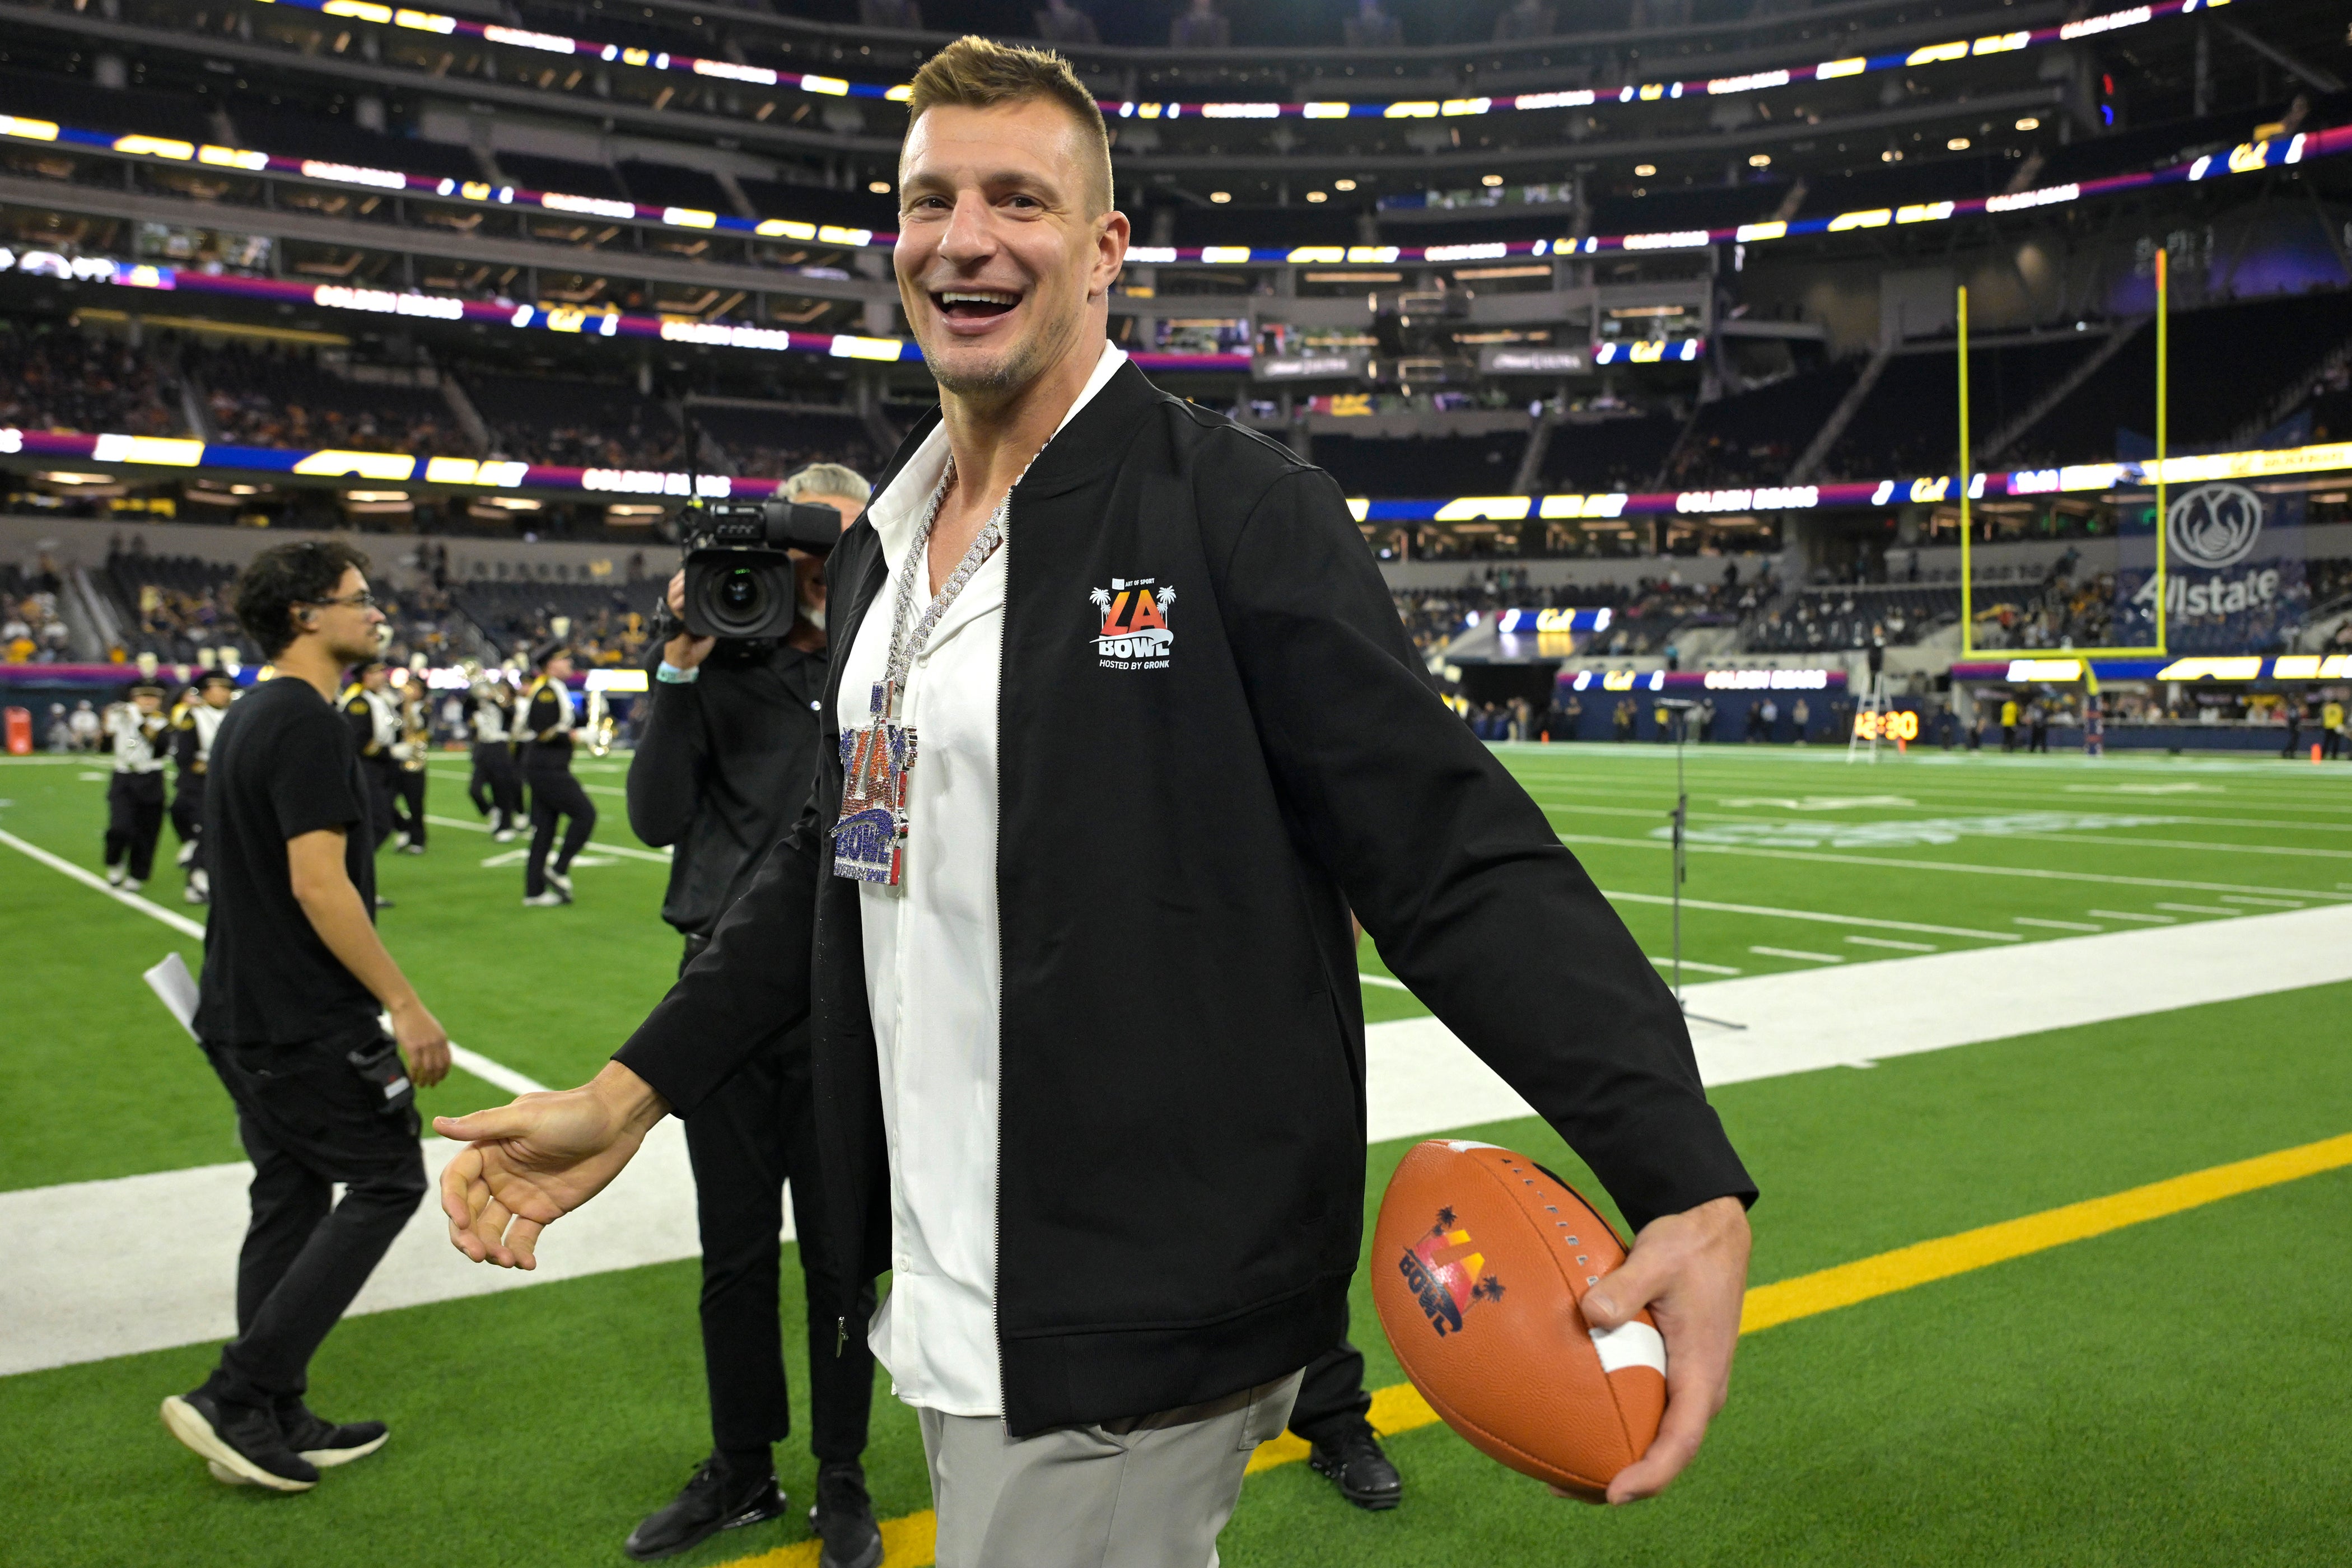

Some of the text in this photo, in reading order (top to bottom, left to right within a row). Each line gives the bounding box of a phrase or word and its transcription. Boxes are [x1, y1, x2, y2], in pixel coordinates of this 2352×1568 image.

[1100, 589, 1167, 636] LA
[2132, 567, 2280, 617] Allstate
[1099, 636, 1170, 659] BOWL
[1099, 659, 1170, 670] HOSTED BY GRONK
[840, 729, 895, 816] LA
